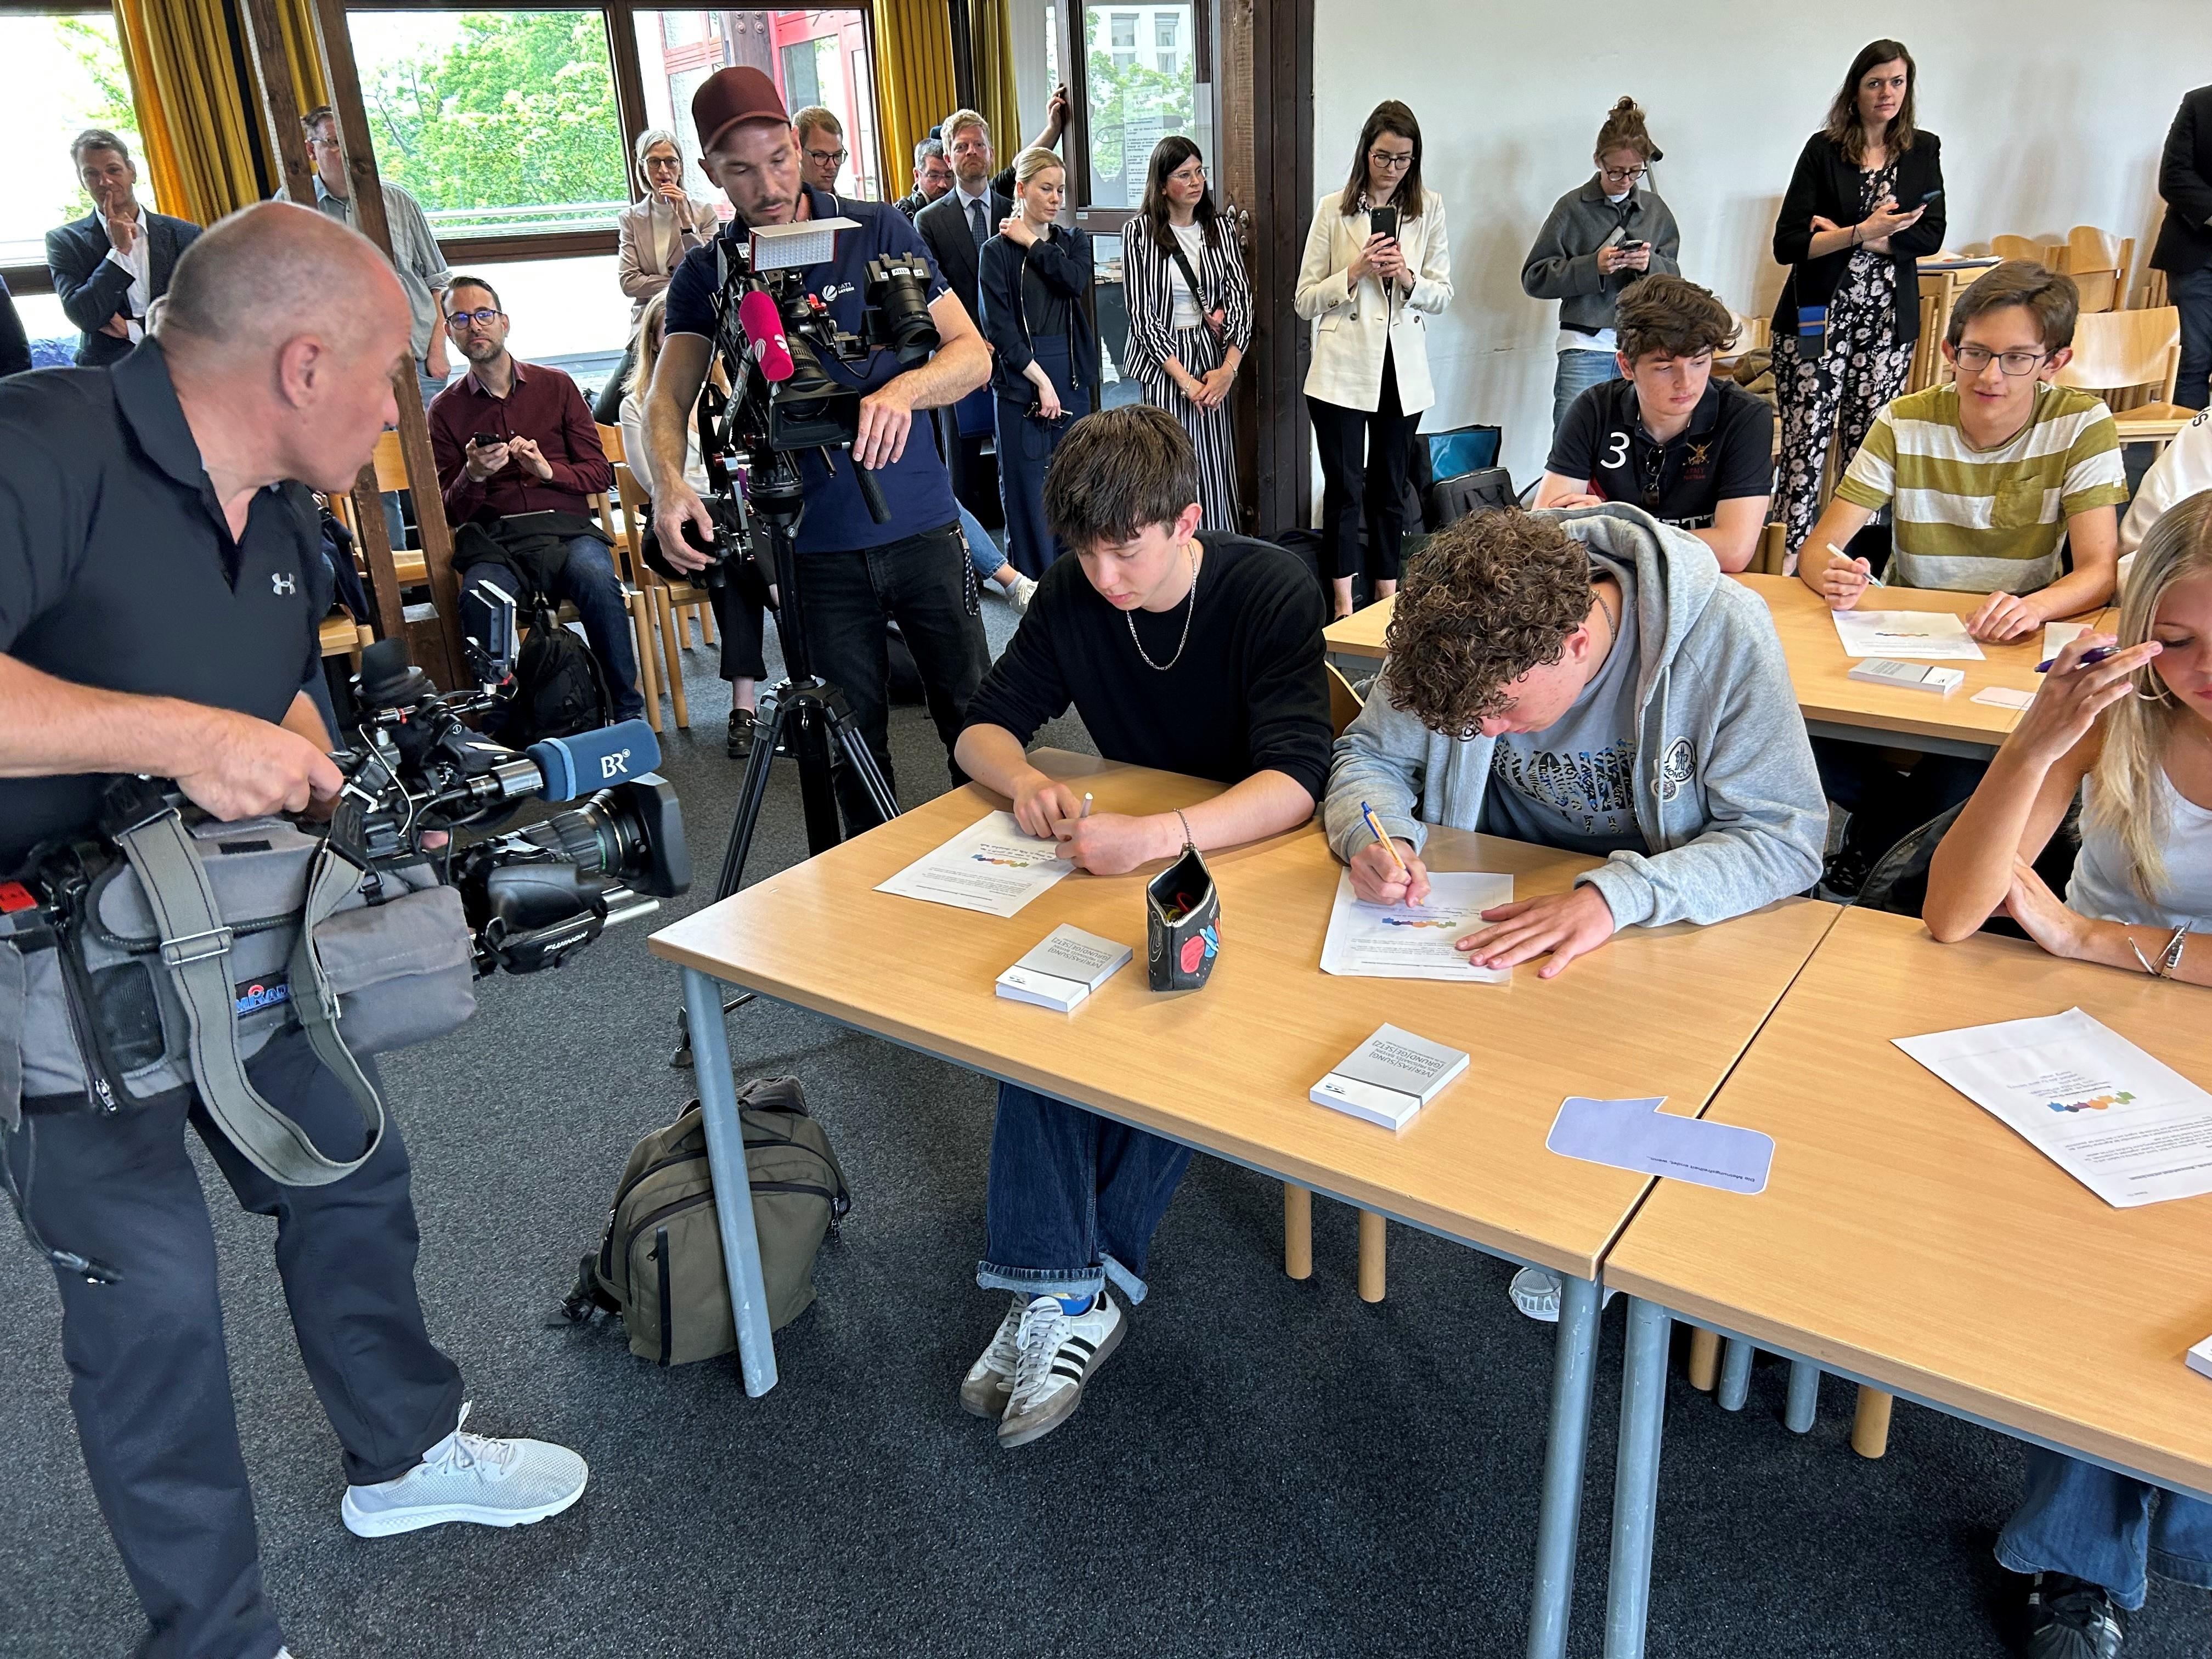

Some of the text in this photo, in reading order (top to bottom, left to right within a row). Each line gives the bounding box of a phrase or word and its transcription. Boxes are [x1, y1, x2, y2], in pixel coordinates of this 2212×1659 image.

[724, 380, 742, 426] SONY
[1600, 432, 1630, 469] 3
[601, 753, 628, 778] BR
[1663, 764, 1694, 778] MONCLER
